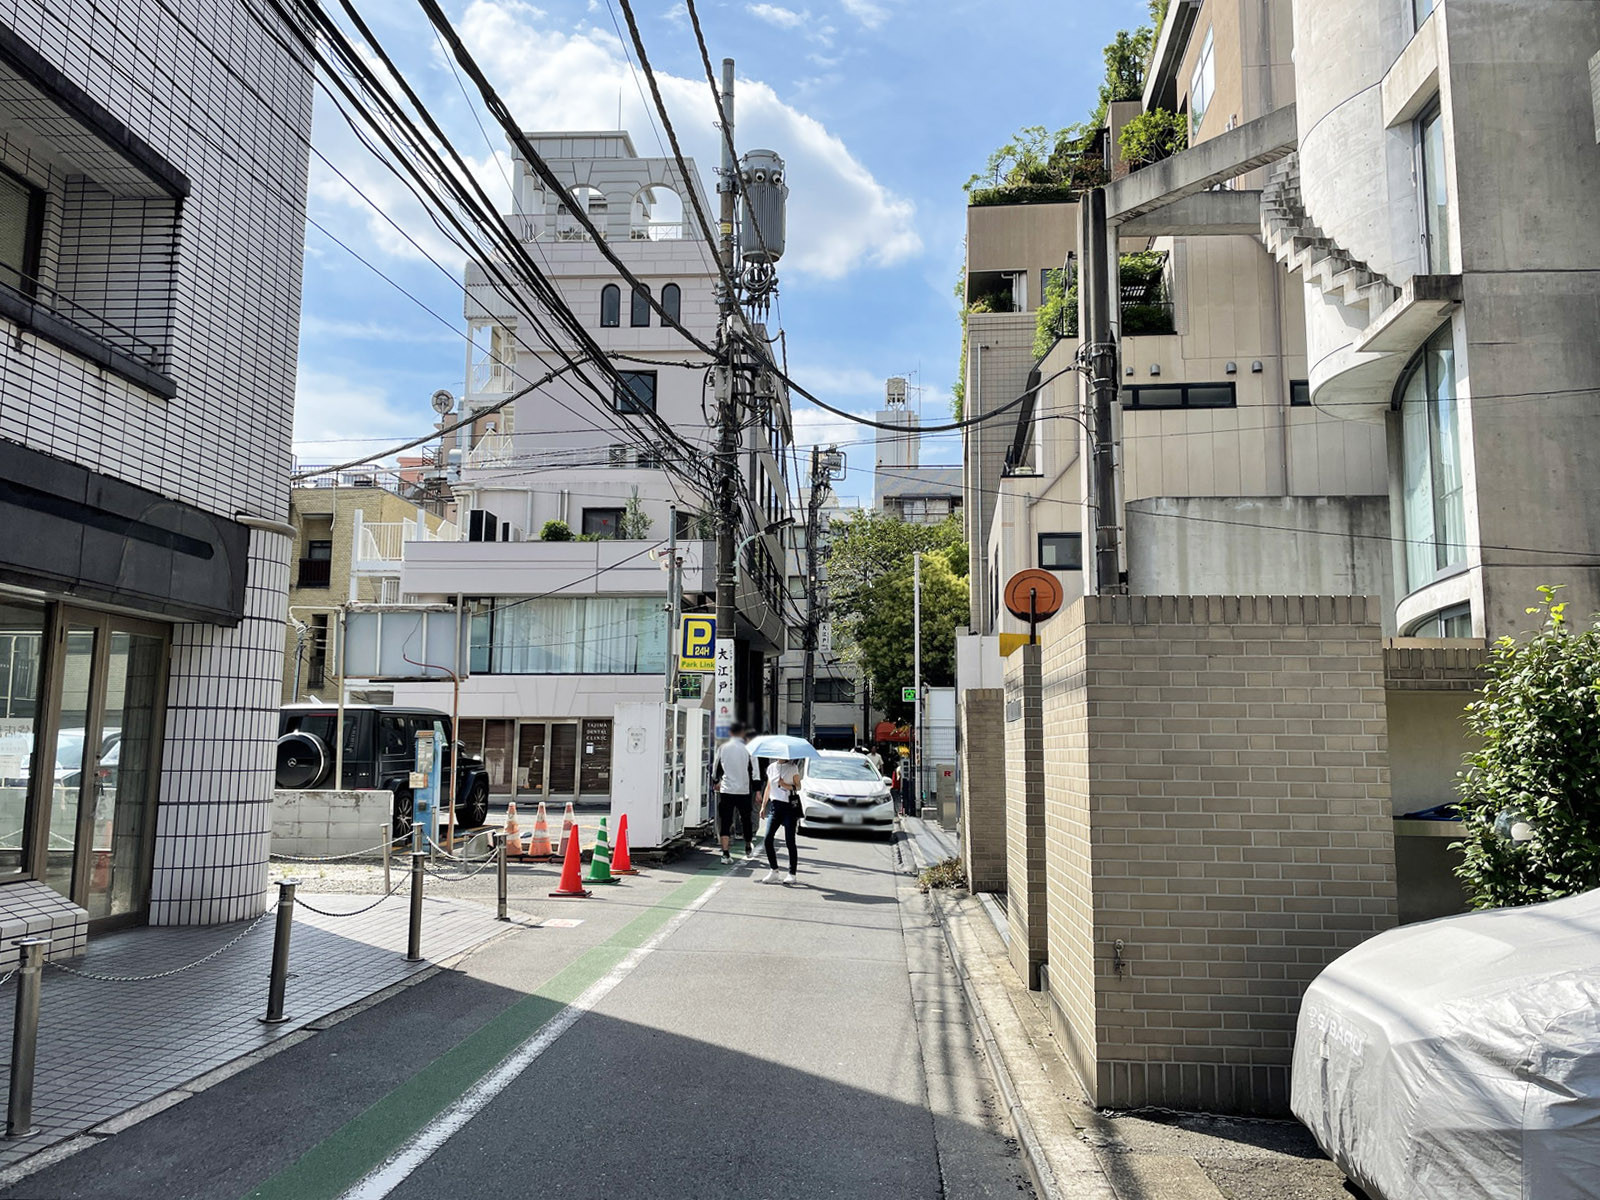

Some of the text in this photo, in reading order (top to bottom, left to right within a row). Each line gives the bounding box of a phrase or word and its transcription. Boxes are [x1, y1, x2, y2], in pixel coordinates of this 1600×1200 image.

[686, 621, 712, 656] P
[694, 646, 710, 656] 24H
[681, 660, 715, 668] Park Link
[718, 648, 729, 693] 大江戸
[1317, 1013, 1362, 1057] SUBARU
